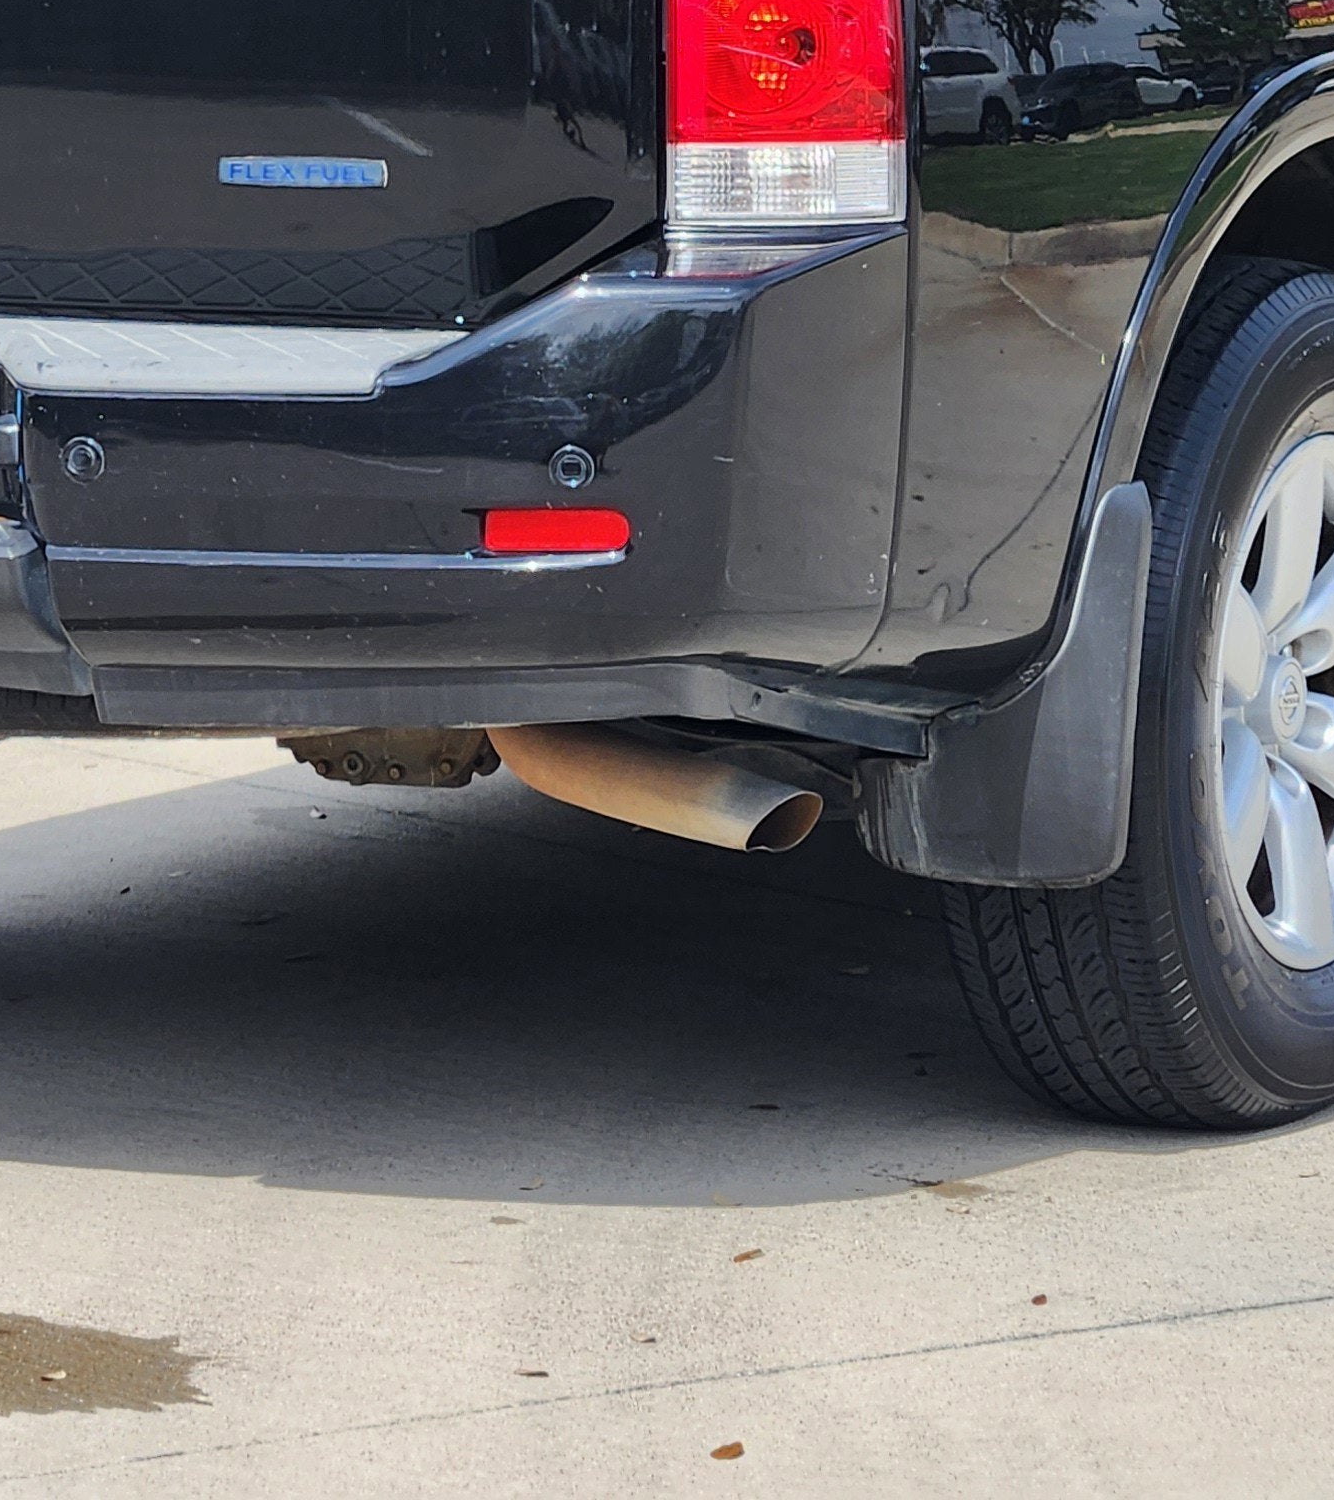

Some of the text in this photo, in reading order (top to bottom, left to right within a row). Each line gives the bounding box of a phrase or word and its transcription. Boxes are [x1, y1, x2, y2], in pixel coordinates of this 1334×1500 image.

[228, 162, 375, 184] FLEX FUEL
[1189, 752, 1250, 1012] TOYO
